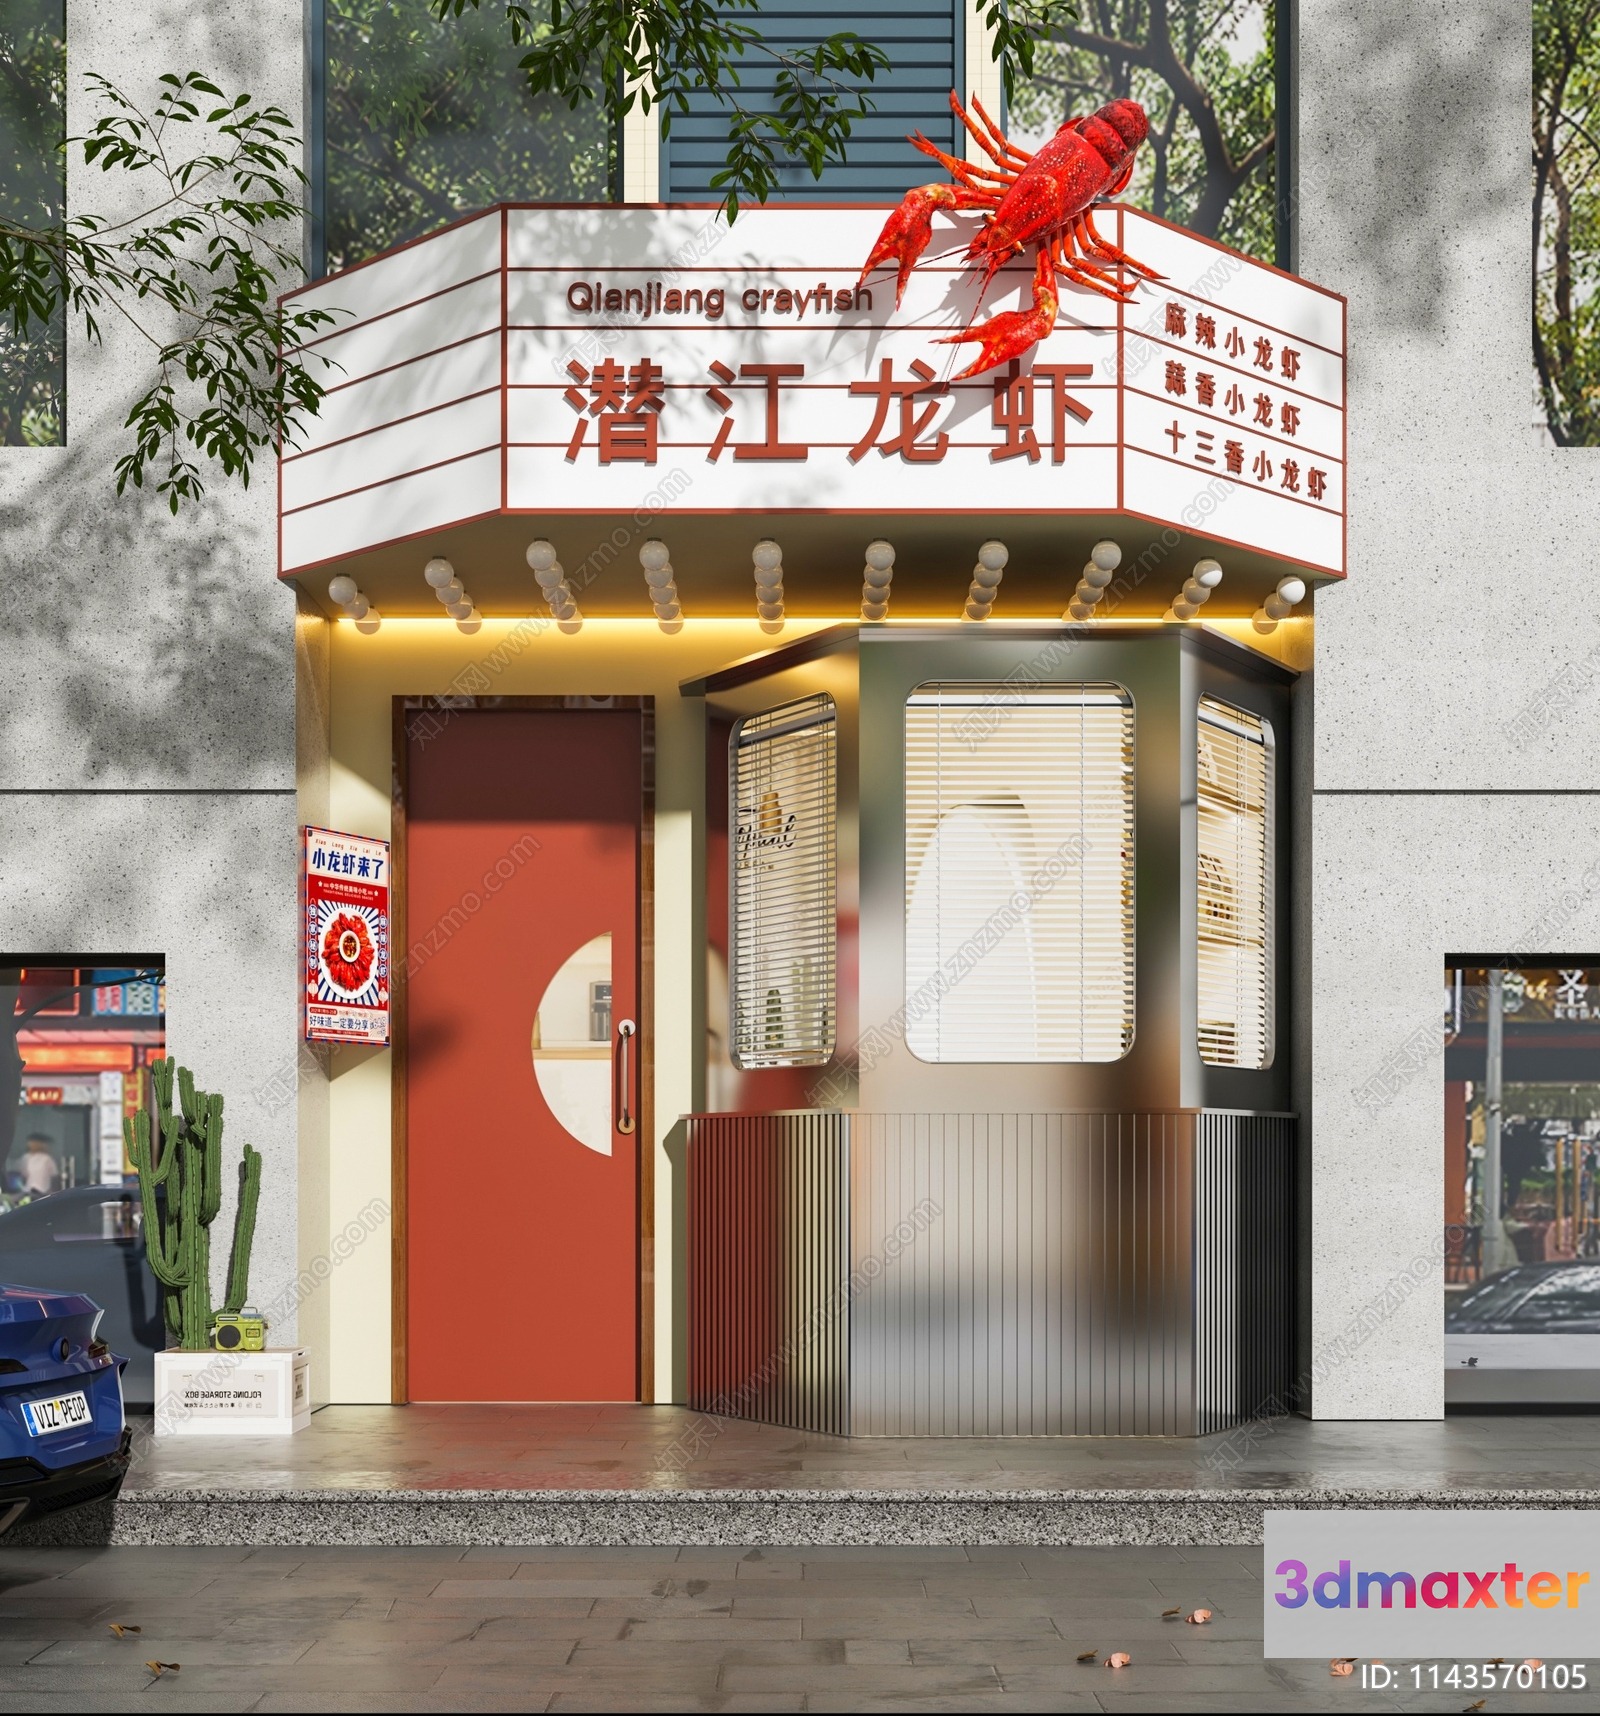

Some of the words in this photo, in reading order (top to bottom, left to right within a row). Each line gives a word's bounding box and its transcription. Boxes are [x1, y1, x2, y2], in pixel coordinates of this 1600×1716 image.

[567, 281, 725, 317] Qianjiang
[742, 283, 873, 318] crayfish
[1165, 303, 1301, 381] 麻辣小龙虾
[564, 358, 1094, 465] 潜江龙虾
[1165, 360, 1301, 436] 蒜香小龙虾
[1165, 420, 1328, 500] 十三香小龙虾
[312, 848, 384, 880] 小龙虾来了
[309, 1016, 368, 1030] 好味道一定要分享
[34, 1402, 60, 1430] VIZ
